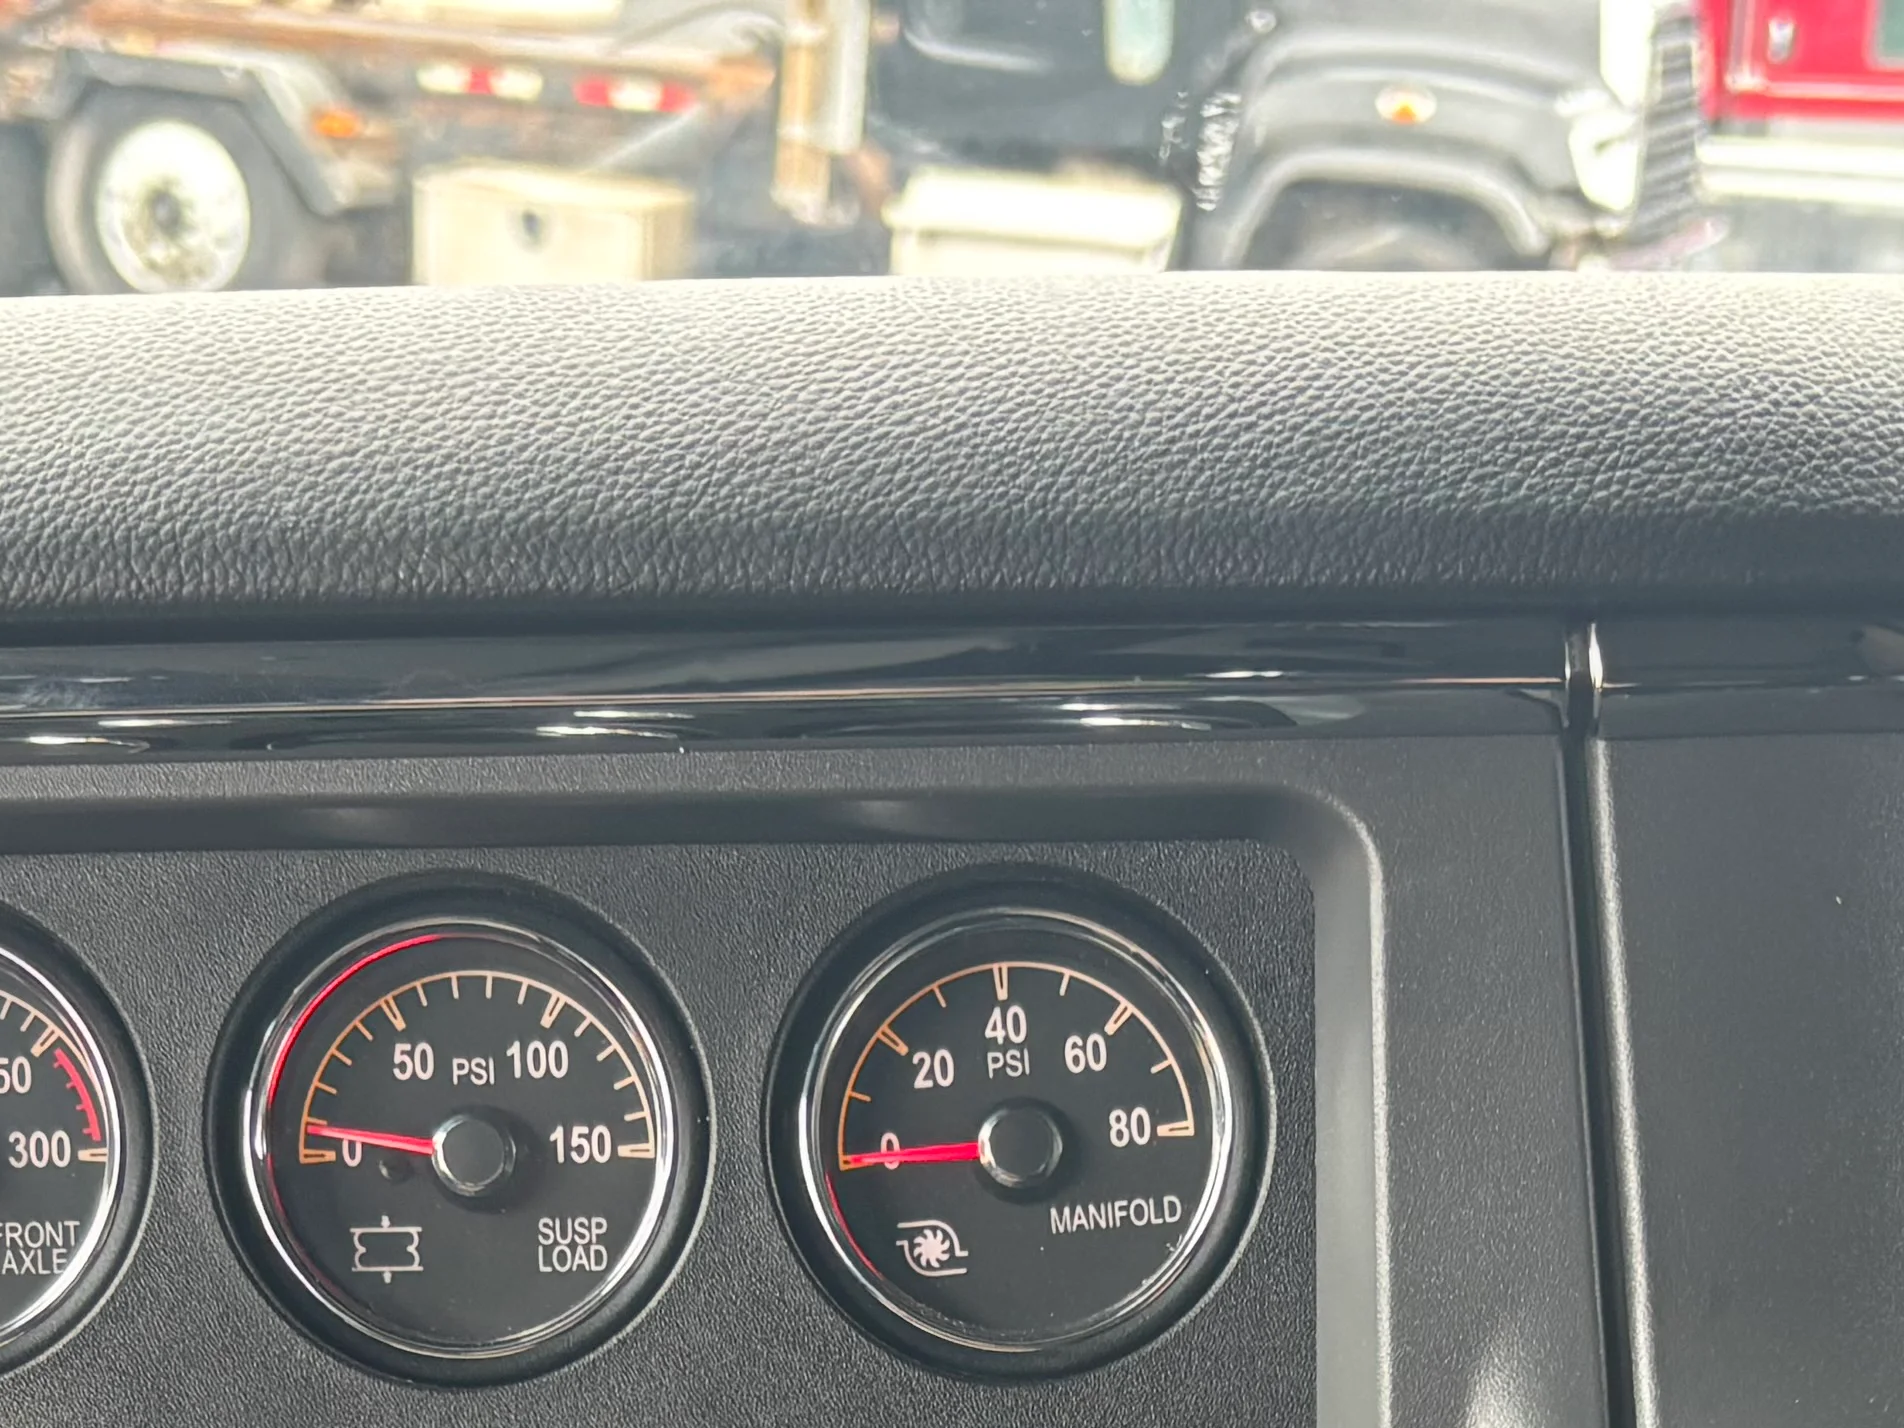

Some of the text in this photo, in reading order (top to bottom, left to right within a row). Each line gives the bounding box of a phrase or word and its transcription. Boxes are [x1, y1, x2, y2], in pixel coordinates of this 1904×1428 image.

[984, 1005, 1027, 1044] 40
[393, 1040, 569, 1086] 50 PSI 100
[912, 1048, 955, 1089] 20
[987, 1051, 1030, 1079] PSI
[1064, 1033, 1107, 1074] 60
[550, 1125, 612, 1164] 150
[1108, 1107, 1152, 1148] 80
[8, 1131, 71, 1168] 300
[537, 1217, 608, 1246] SUSP
[1049, 1195, 1183, 1235] MANIFOLD
[2, 1249, 67, 1275] AXLE
[537, 1245, 608, 1273] LOAD
